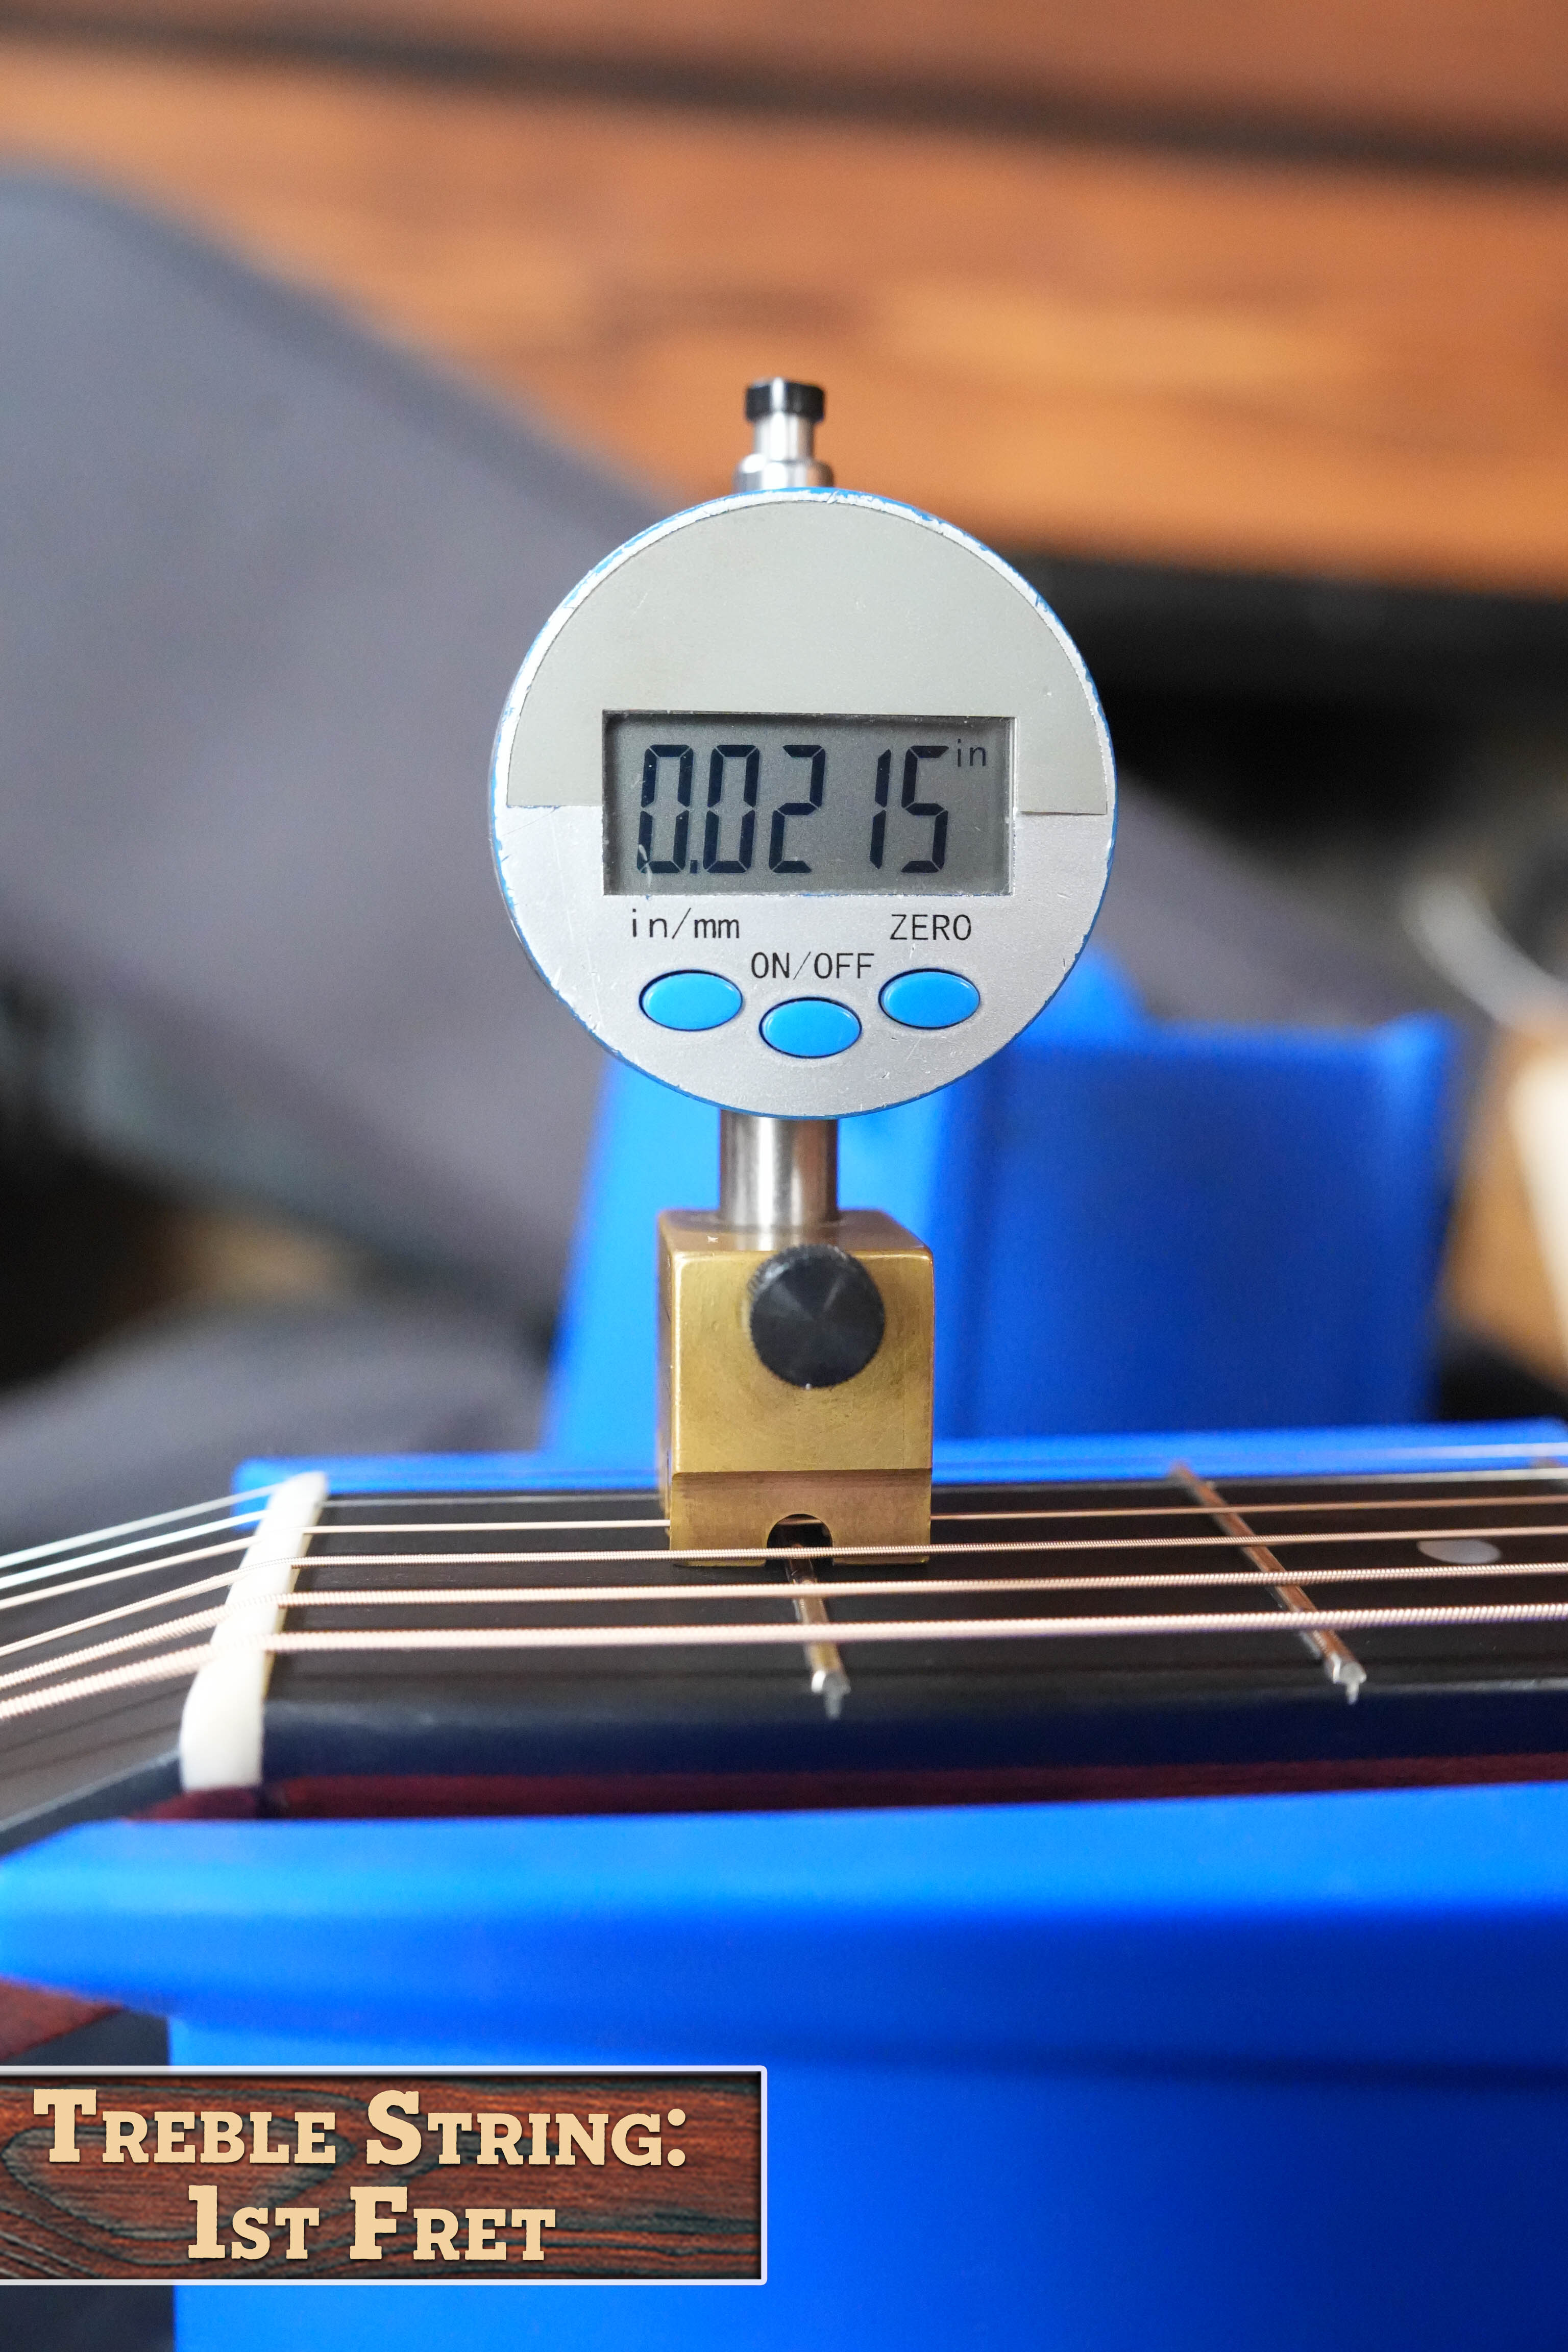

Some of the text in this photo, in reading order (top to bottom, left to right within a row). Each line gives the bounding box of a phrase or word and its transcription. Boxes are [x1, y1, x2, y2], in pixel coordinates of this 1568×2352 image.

[636, 738, 987, 874] 0.0215 in
[631, 907, 741, 940] in/mm
[890, 914, 972, 941] ZERO
[750, 951, 875, 980] ON/OFF
